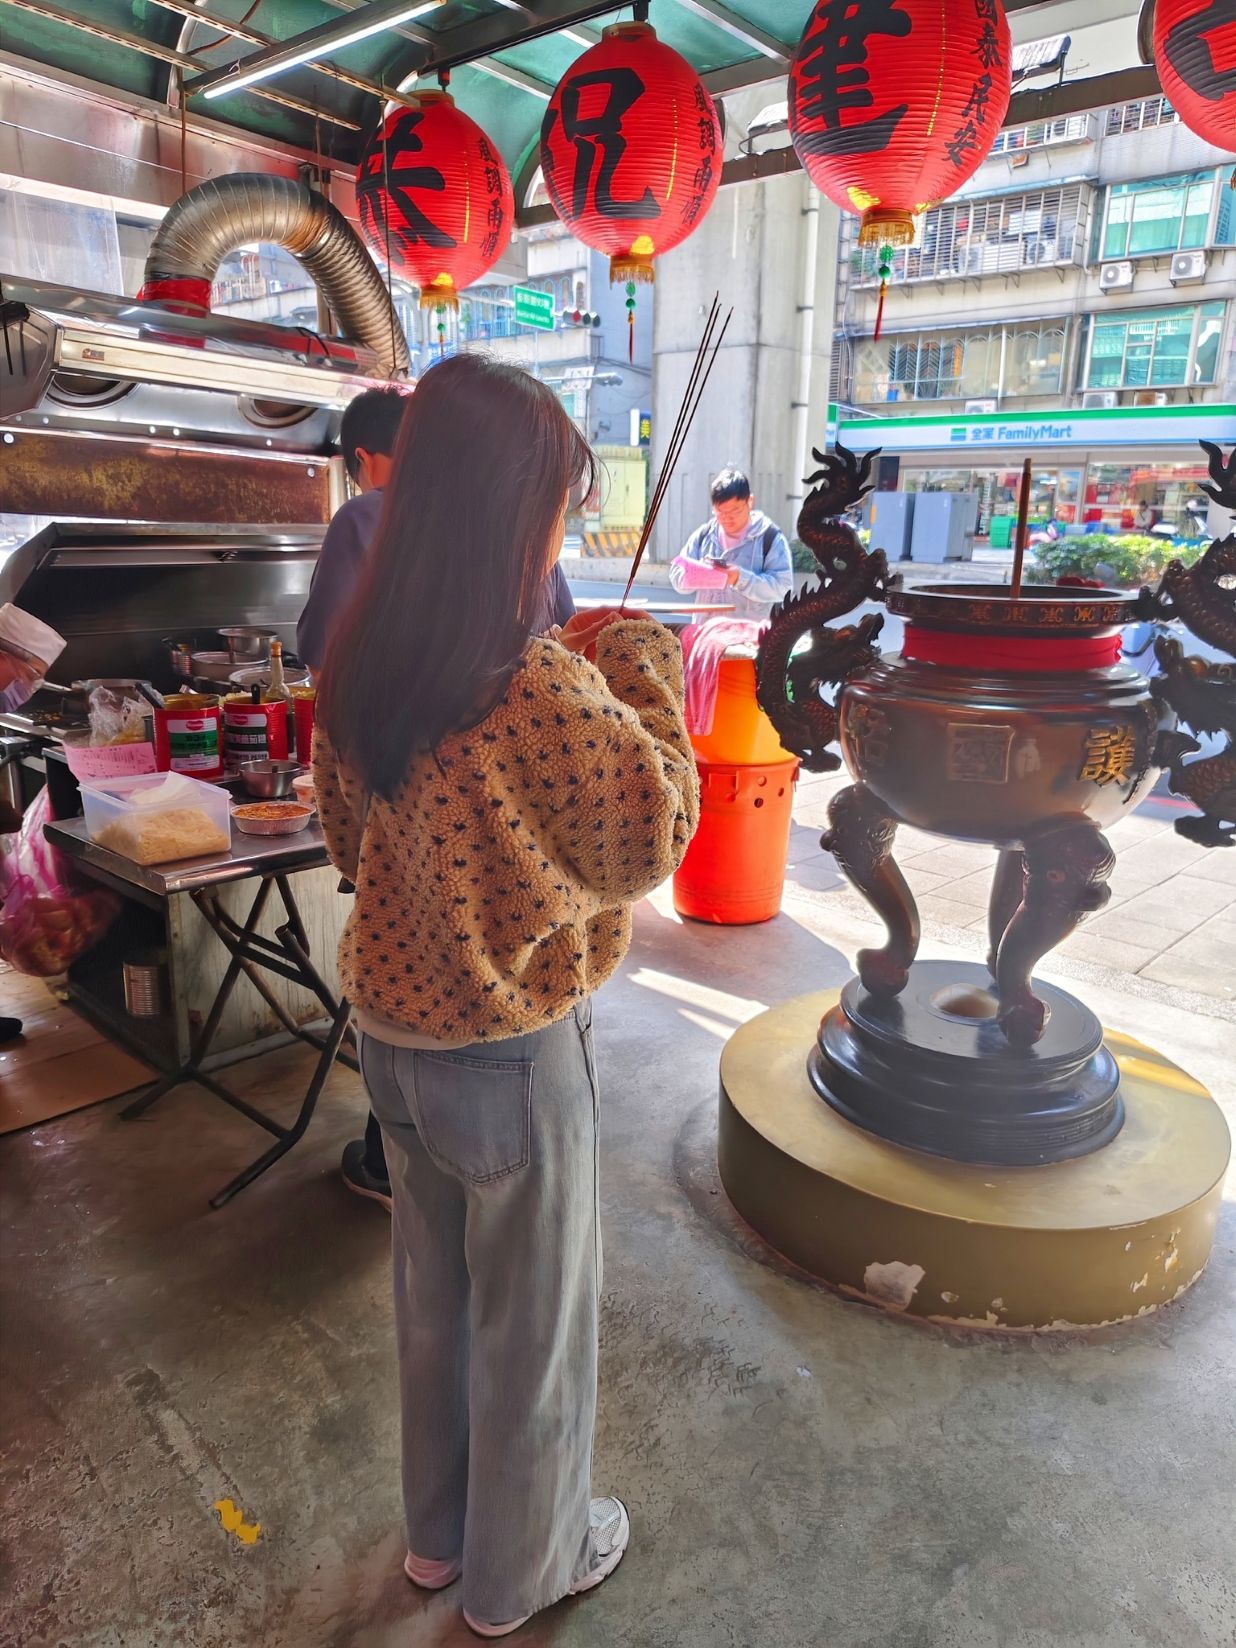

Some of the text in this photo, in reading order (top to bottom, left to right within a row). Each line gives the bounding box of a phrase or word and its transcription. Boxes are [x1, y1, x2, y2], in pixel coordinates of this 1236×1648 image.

[971, 424, 1073, 441] 全家 FamilyMart
[1077, 724, 1137, 788] 護
